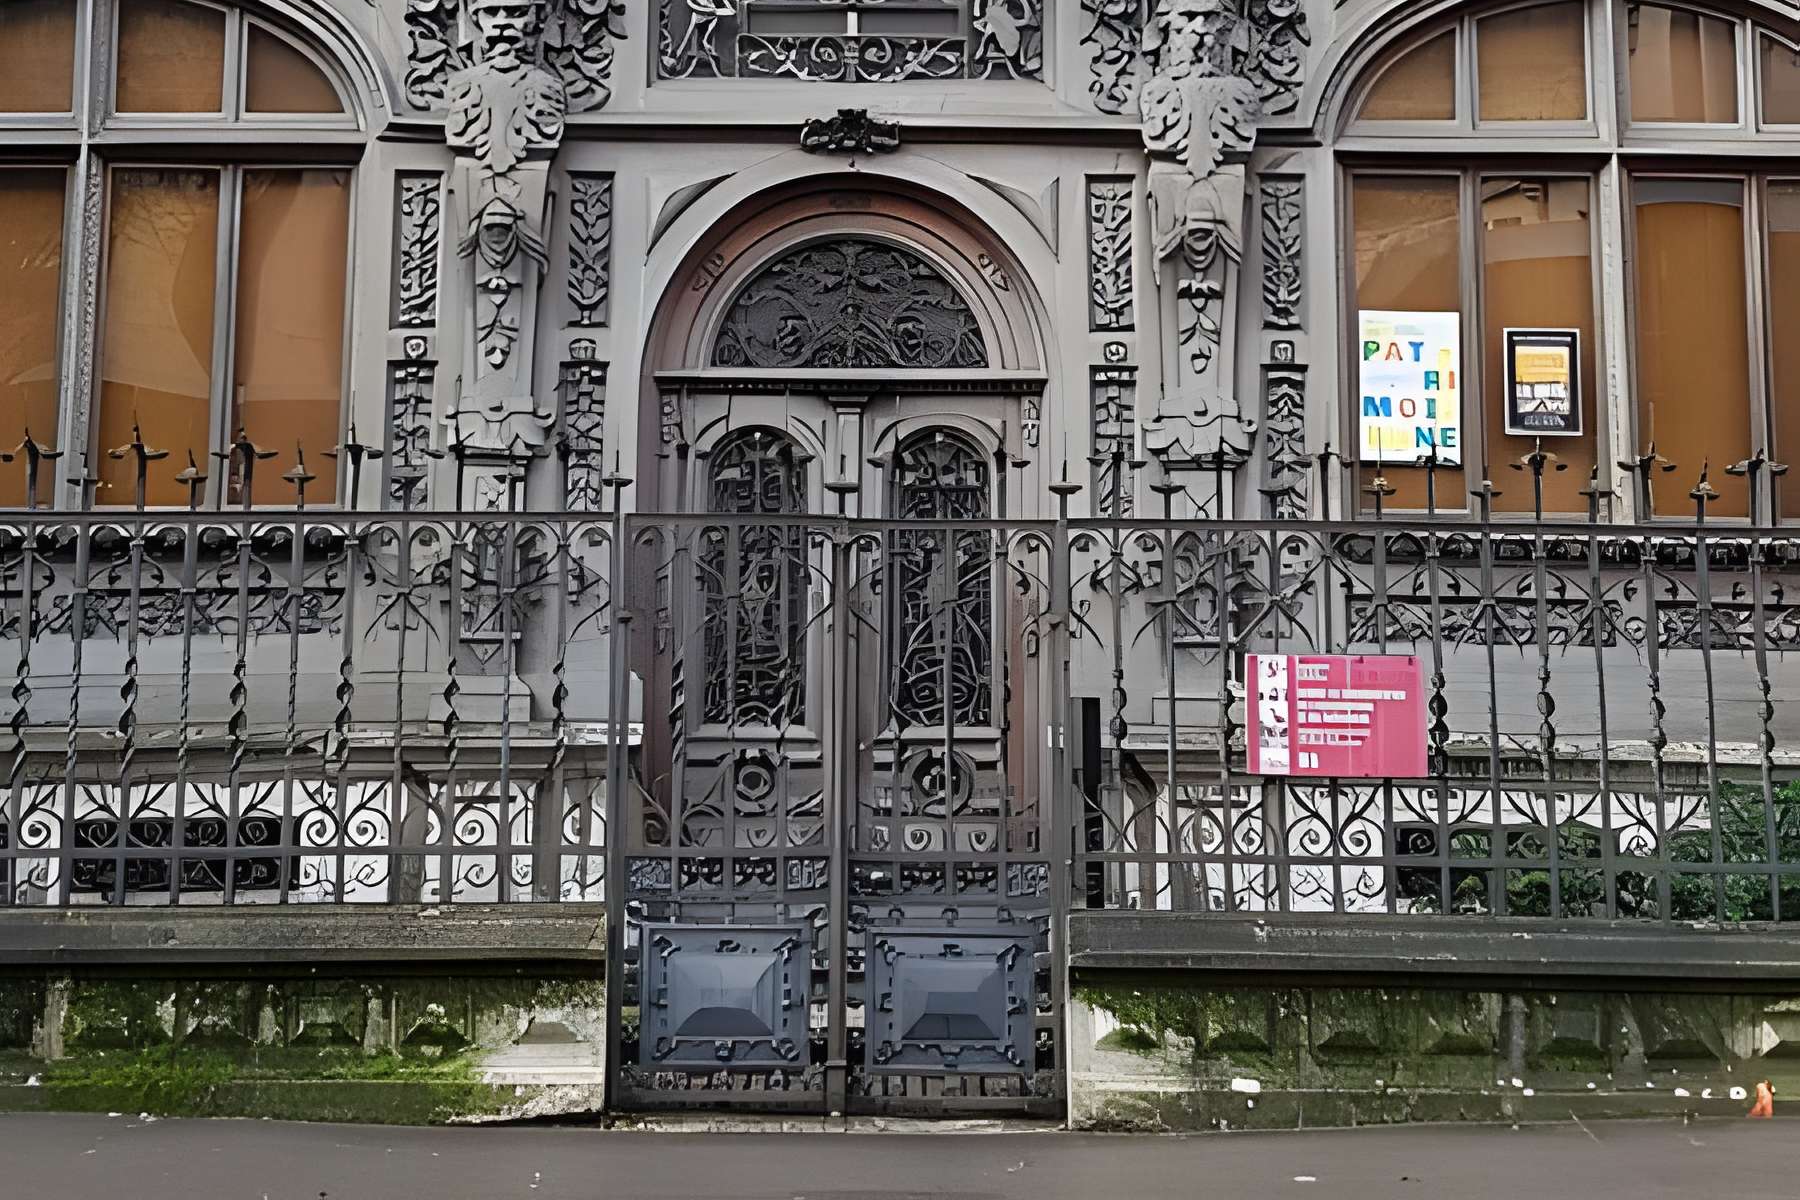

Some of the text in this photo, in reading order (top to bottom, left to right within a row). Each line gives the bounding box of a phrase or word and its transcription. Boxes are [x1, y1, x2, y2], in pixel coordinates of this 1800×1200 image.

[1363, 341, 1424, 362] PAT
[1363, 396, 1436, 419] MOI
[1415, 426, 1456, 448] NE
